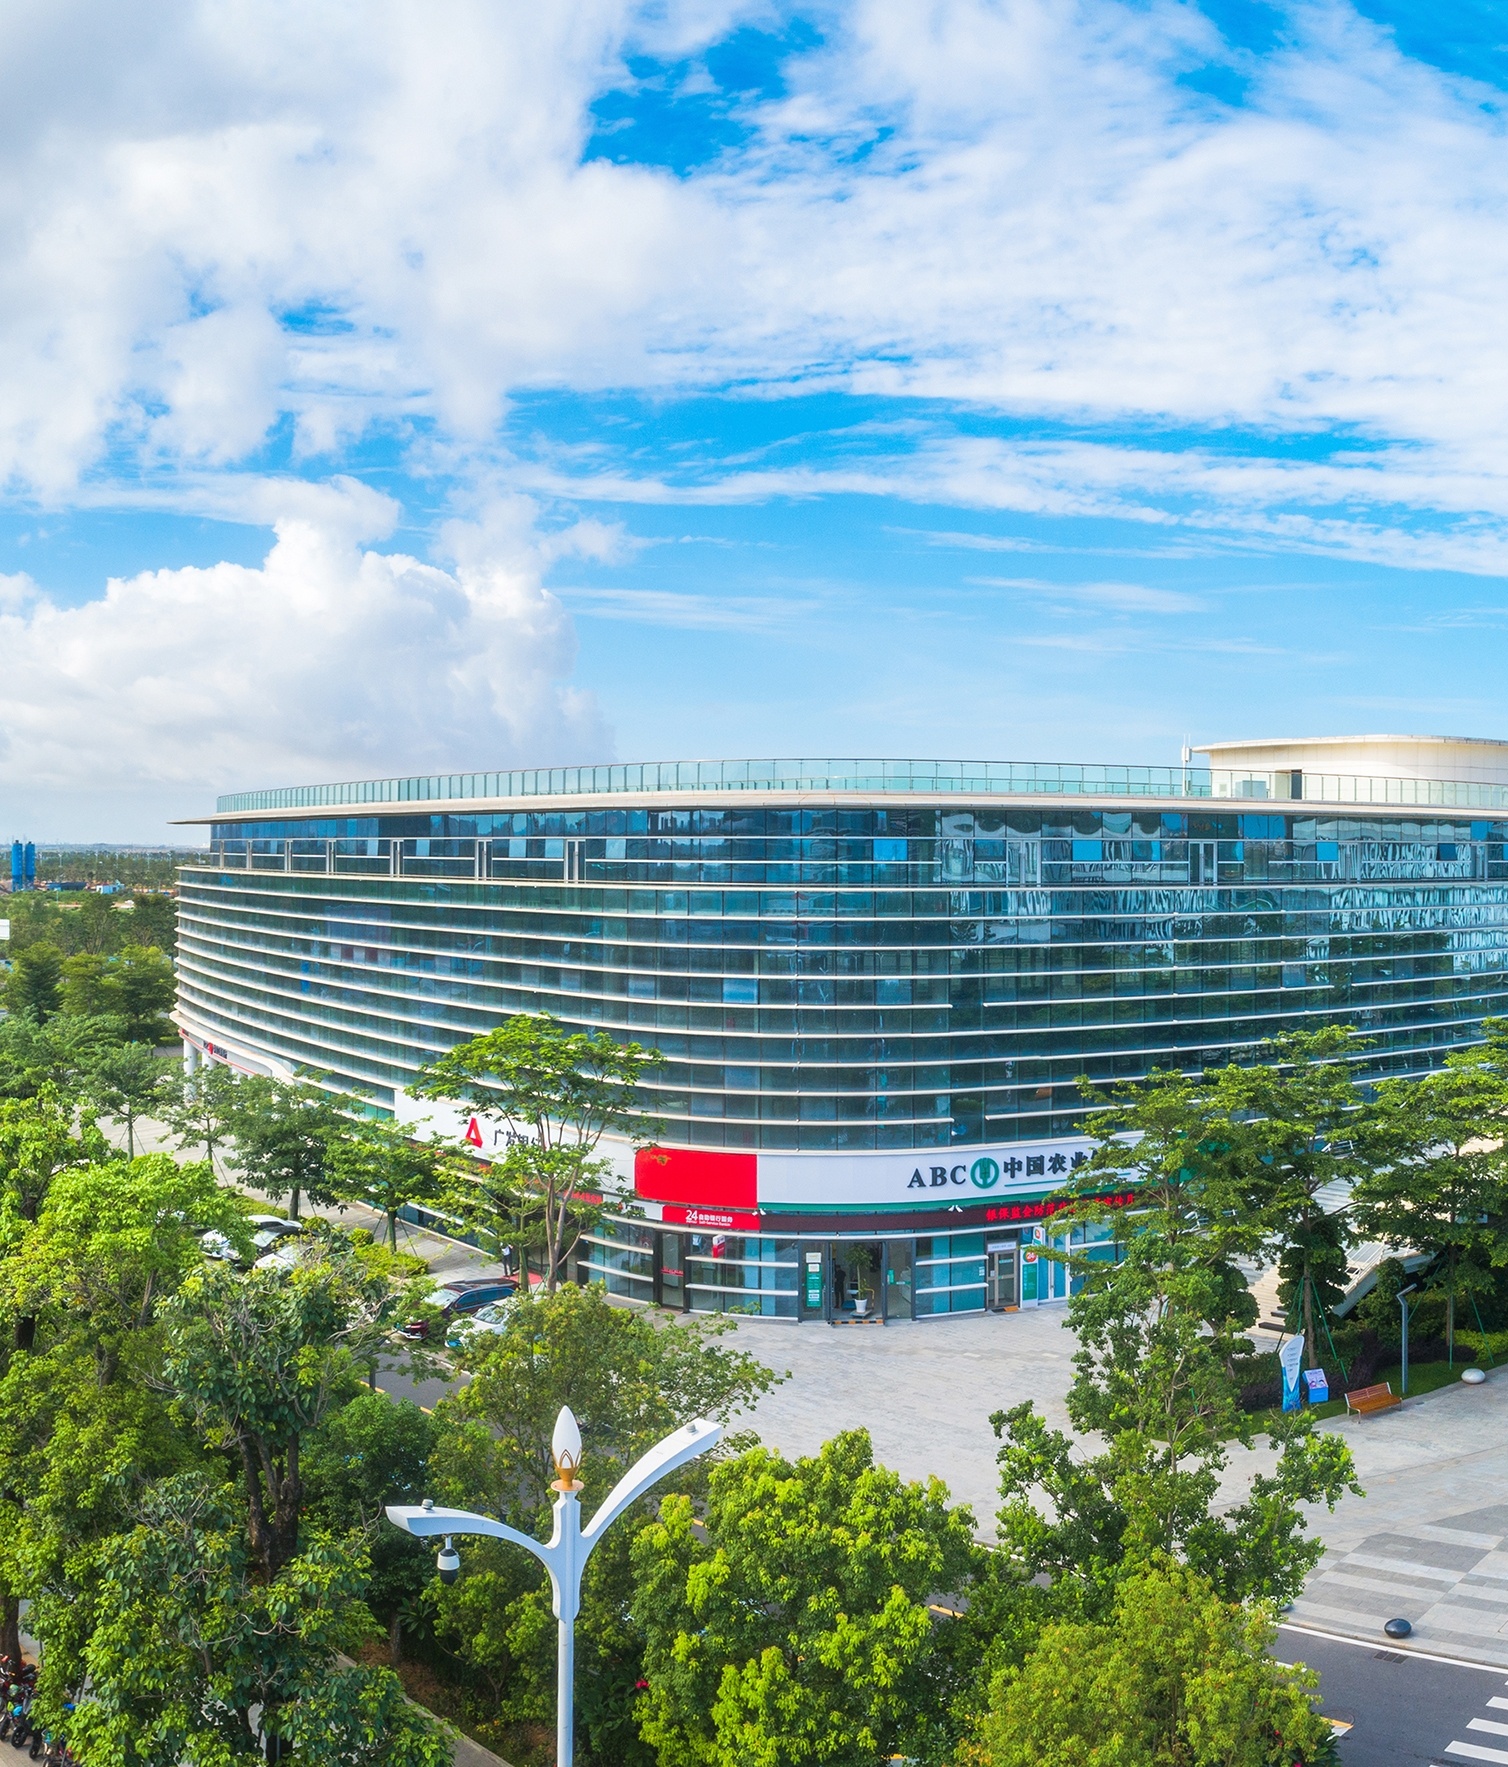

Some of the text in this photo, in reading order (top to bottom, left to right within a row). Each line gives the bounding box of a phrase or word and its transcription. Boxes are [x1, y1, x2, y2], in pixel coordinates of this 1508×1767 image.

[907, 1164, 967, 1188] ABC
[1003, 1150, 1098, 1178] 中国农业
